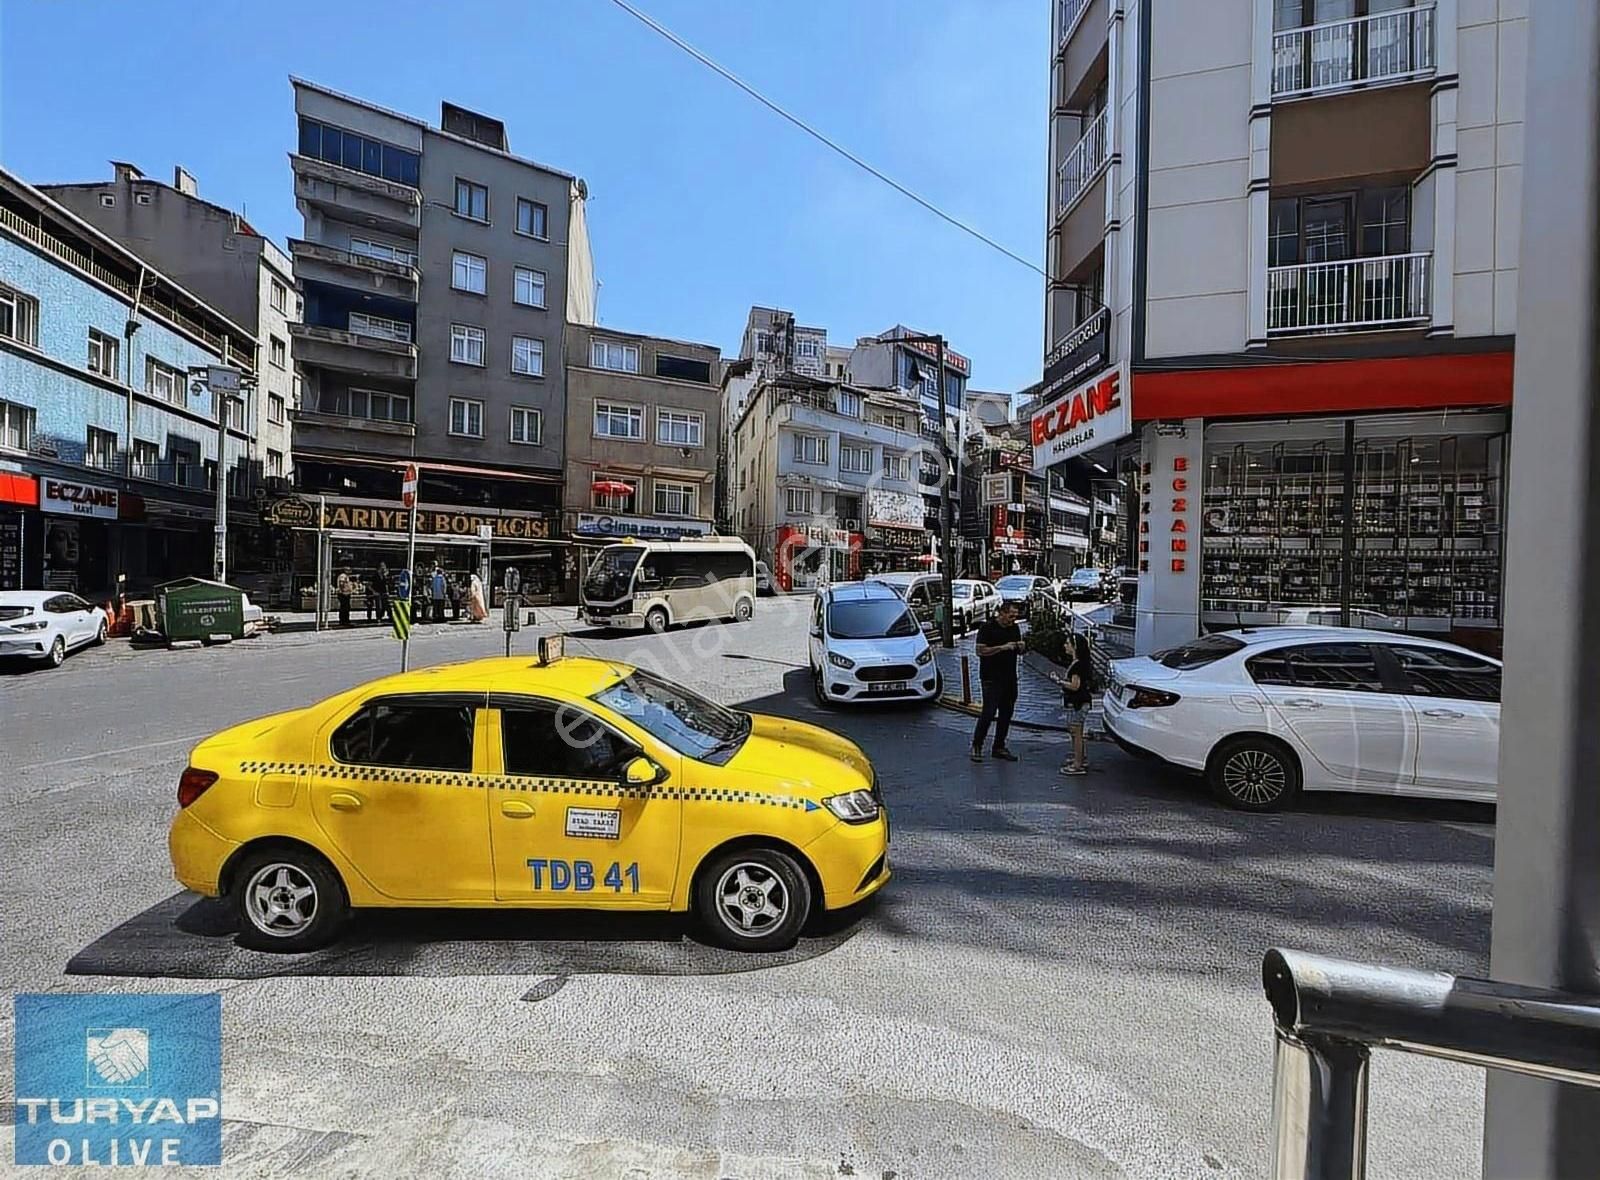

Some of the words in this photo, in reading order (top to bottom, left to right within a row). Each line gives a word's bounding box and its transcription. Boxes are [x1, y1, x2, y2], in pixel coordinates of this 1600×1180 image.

[1034, 370, 1121, 446] ECZANE
[46, 480, 117, 508] ECZANE
[315, 506, 425, 531] SARIYER
[1171, 457, 1189, 572] ECZANE
[527, 859, 595, 891] TDB
[604, 861, 639, 894] 41
